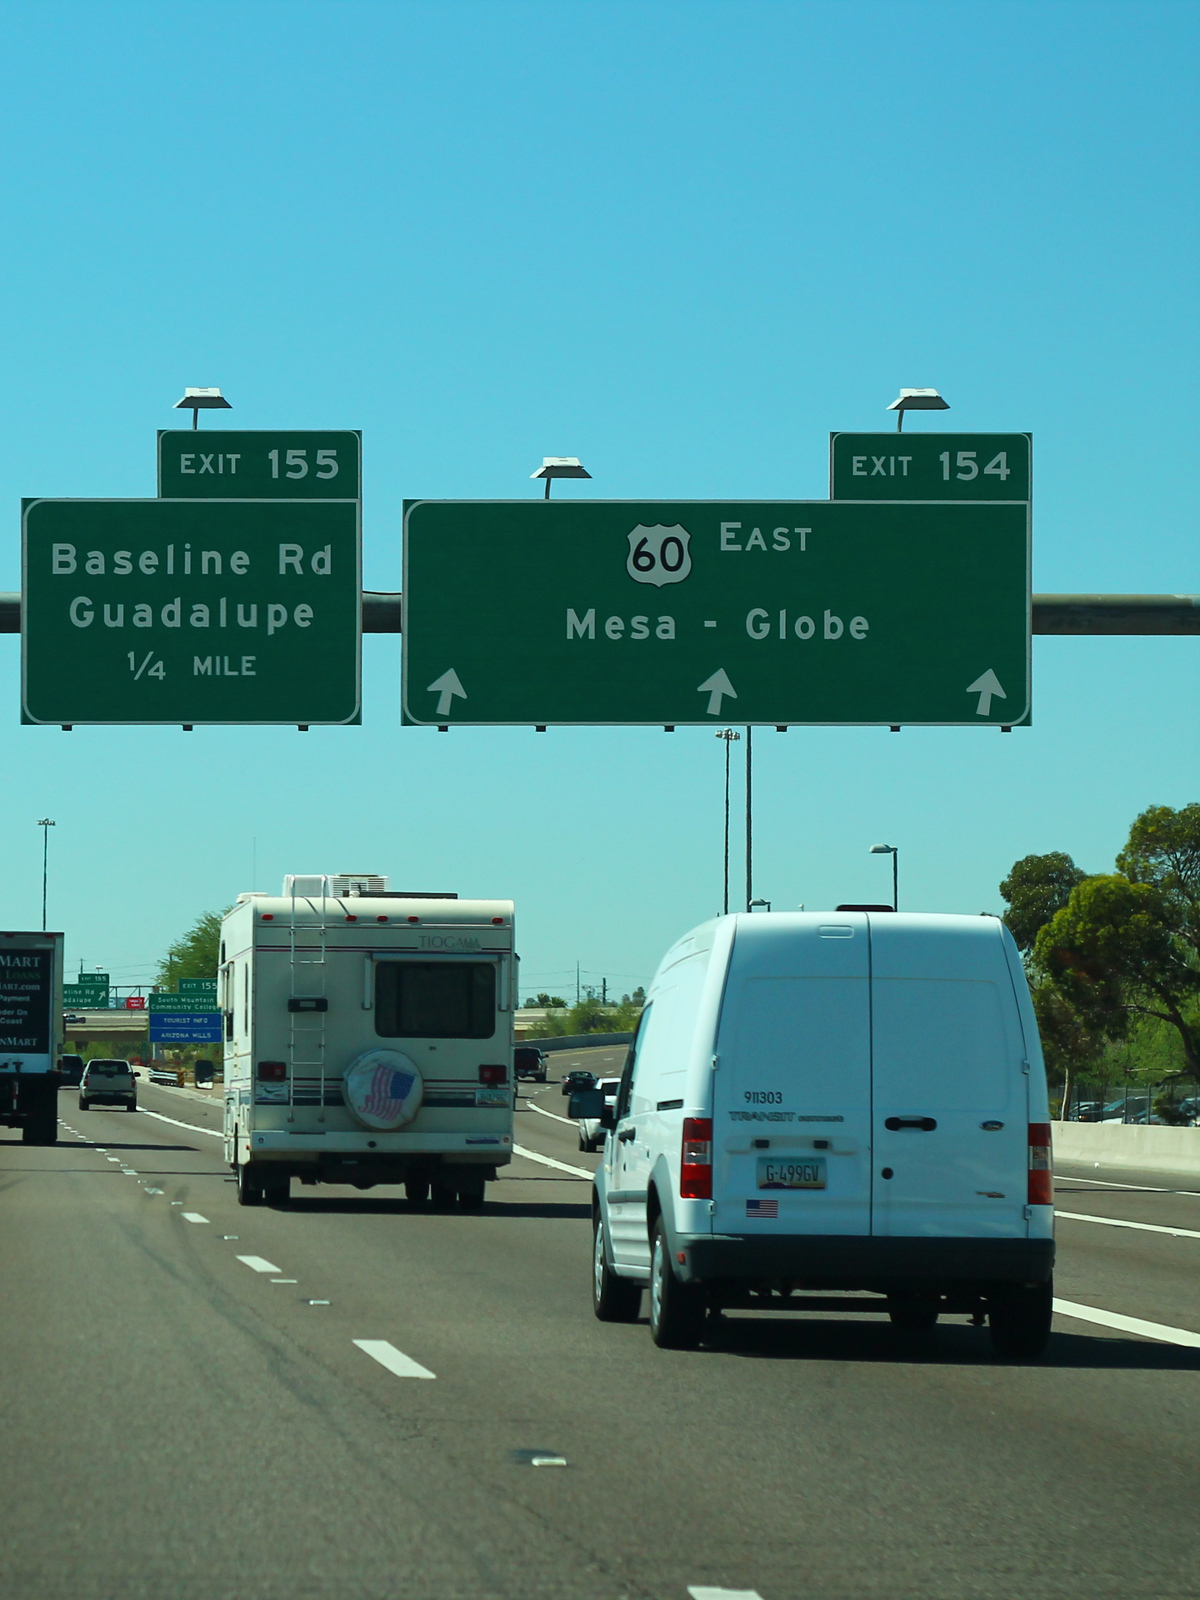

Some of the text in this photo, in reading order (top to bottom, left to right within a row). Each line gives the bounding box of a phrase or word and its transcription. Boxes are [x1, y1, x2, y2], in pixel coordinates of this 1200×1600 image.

[180, 449, 340, 480] EXIT 155
[852, 451, 1011, 481] EXIT 154
[719, 521, 812, 552] EAST
[52, 543, 333, 576] Baseline Rd
[631, 535, 685, 573] 60
[69, 596, 315, 636] Guadalupe
[566, 608, 676, 640] Mesa
[745, 607, 871, 641] Globe
[192, 655, 257, 677] MILE
[419, 936, 465, 948] TIOGA
[6, 970, 41, 980] LOANS
[202, 982, 218, 990] 155
[744, 1091, 783, 1104] 911303
[728, 1111, 796, 1122] TRANSIT
